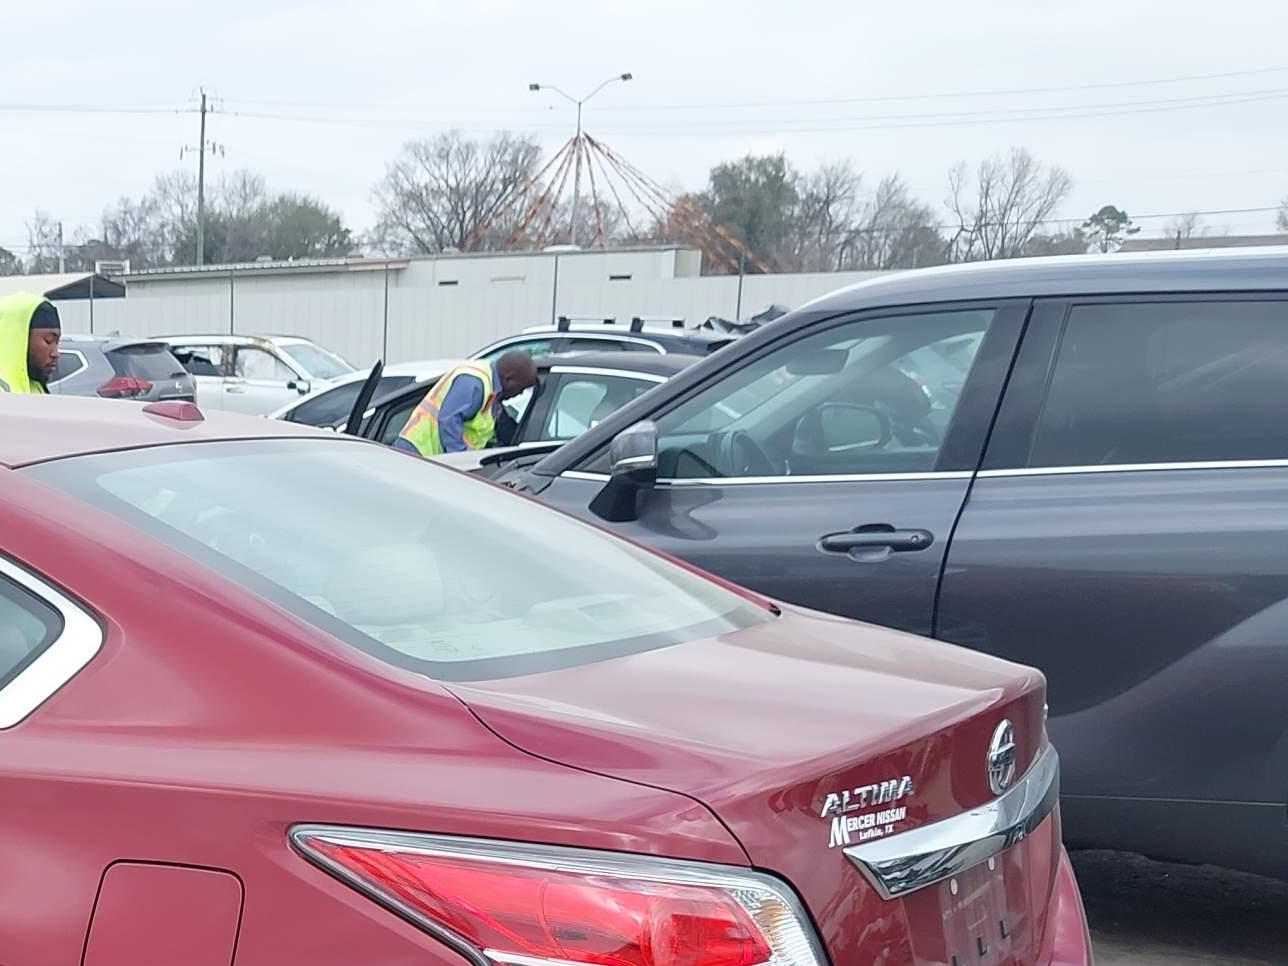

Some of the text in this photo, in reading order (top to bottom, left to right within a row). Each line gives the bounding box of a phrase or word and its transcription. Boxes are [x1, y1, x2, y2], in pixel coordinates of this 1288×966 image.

[820, 775, 915, 818] ALTIMA
[828, 806, 907, 849] MERCER NISSAN
[885, 823, 894, 834] TX
